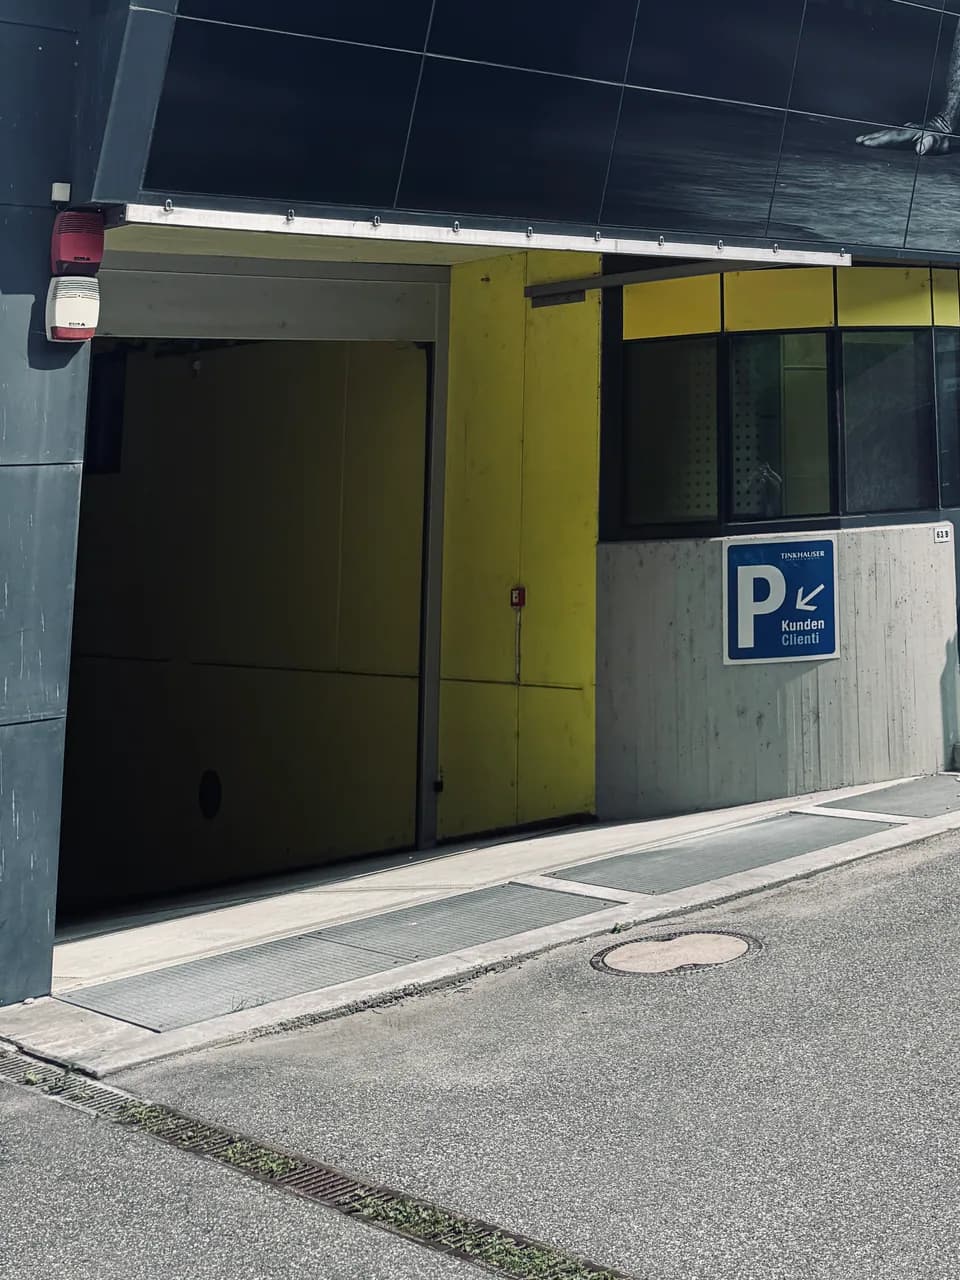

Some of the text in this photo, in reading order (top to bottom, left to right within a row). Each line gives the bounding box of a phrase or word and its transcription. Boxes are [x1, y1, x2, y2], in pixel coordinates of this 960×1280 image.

[781, 550, 825, 559] TINKHAUSER
[737, 564, 786, 649] P
[781, 619, 825, 632] Kunden
[781, 633, 820, 646] Clienti
